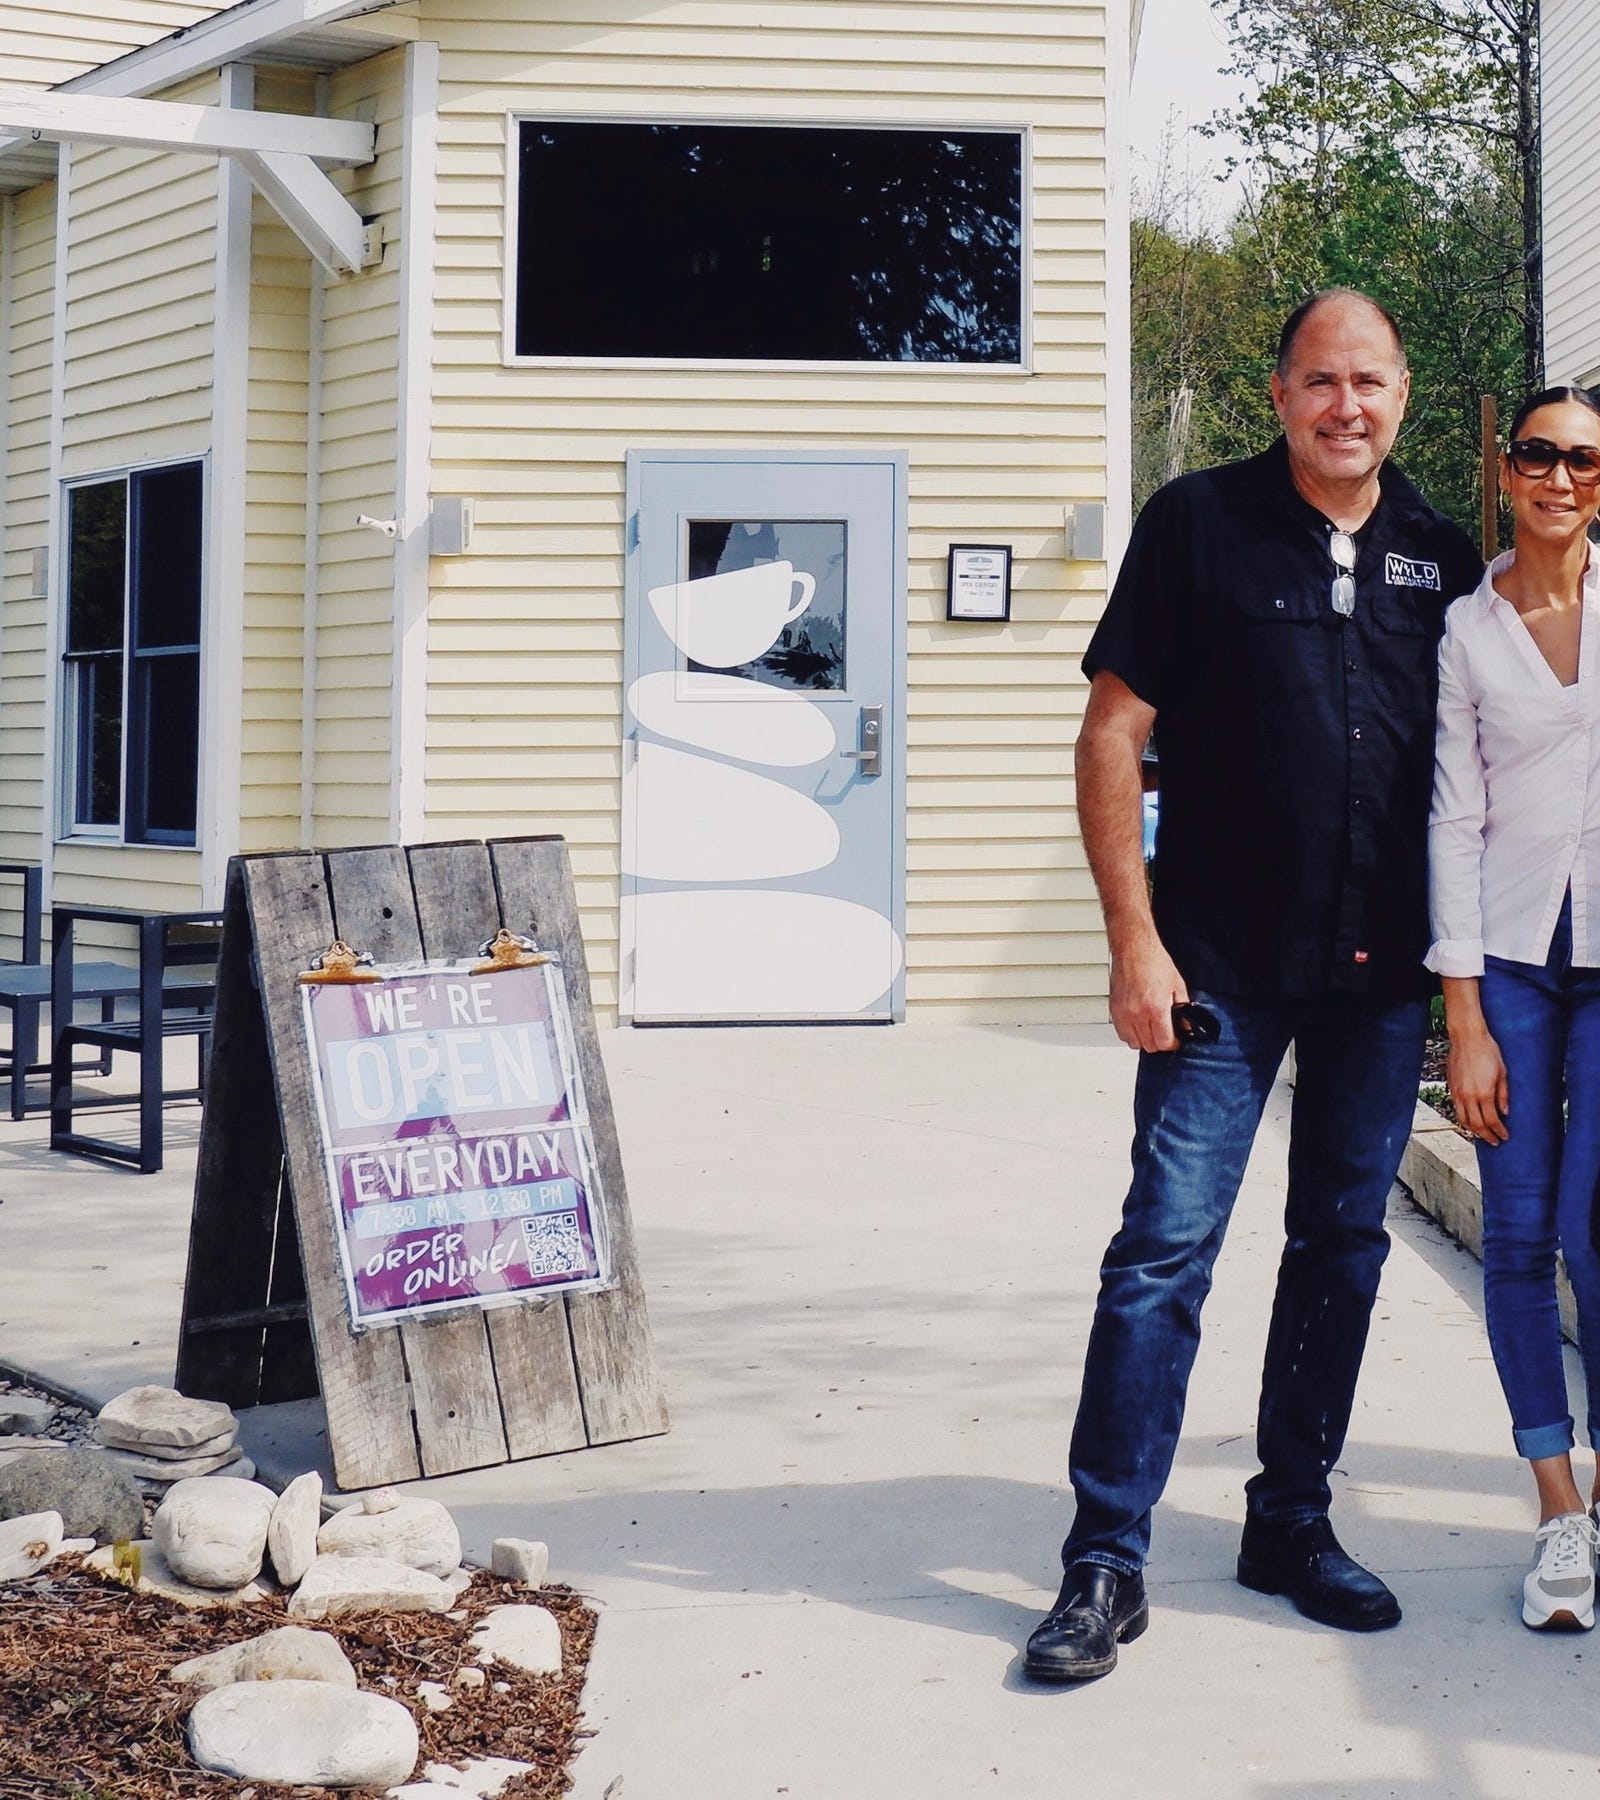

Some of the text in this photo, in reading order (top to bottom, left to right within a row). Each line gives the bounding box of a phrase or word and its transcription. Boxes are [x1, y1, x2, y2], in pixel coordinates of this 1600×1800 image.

[346, 1028, 540, 1121] OPEN
[351, 1132, 561, 1202] EVERYDAY
[540, 1184, 564, 1208] PM
[366, 1232, 463, 1277] ORDER
[403, 1238, 519, 1295] ONLINE!
